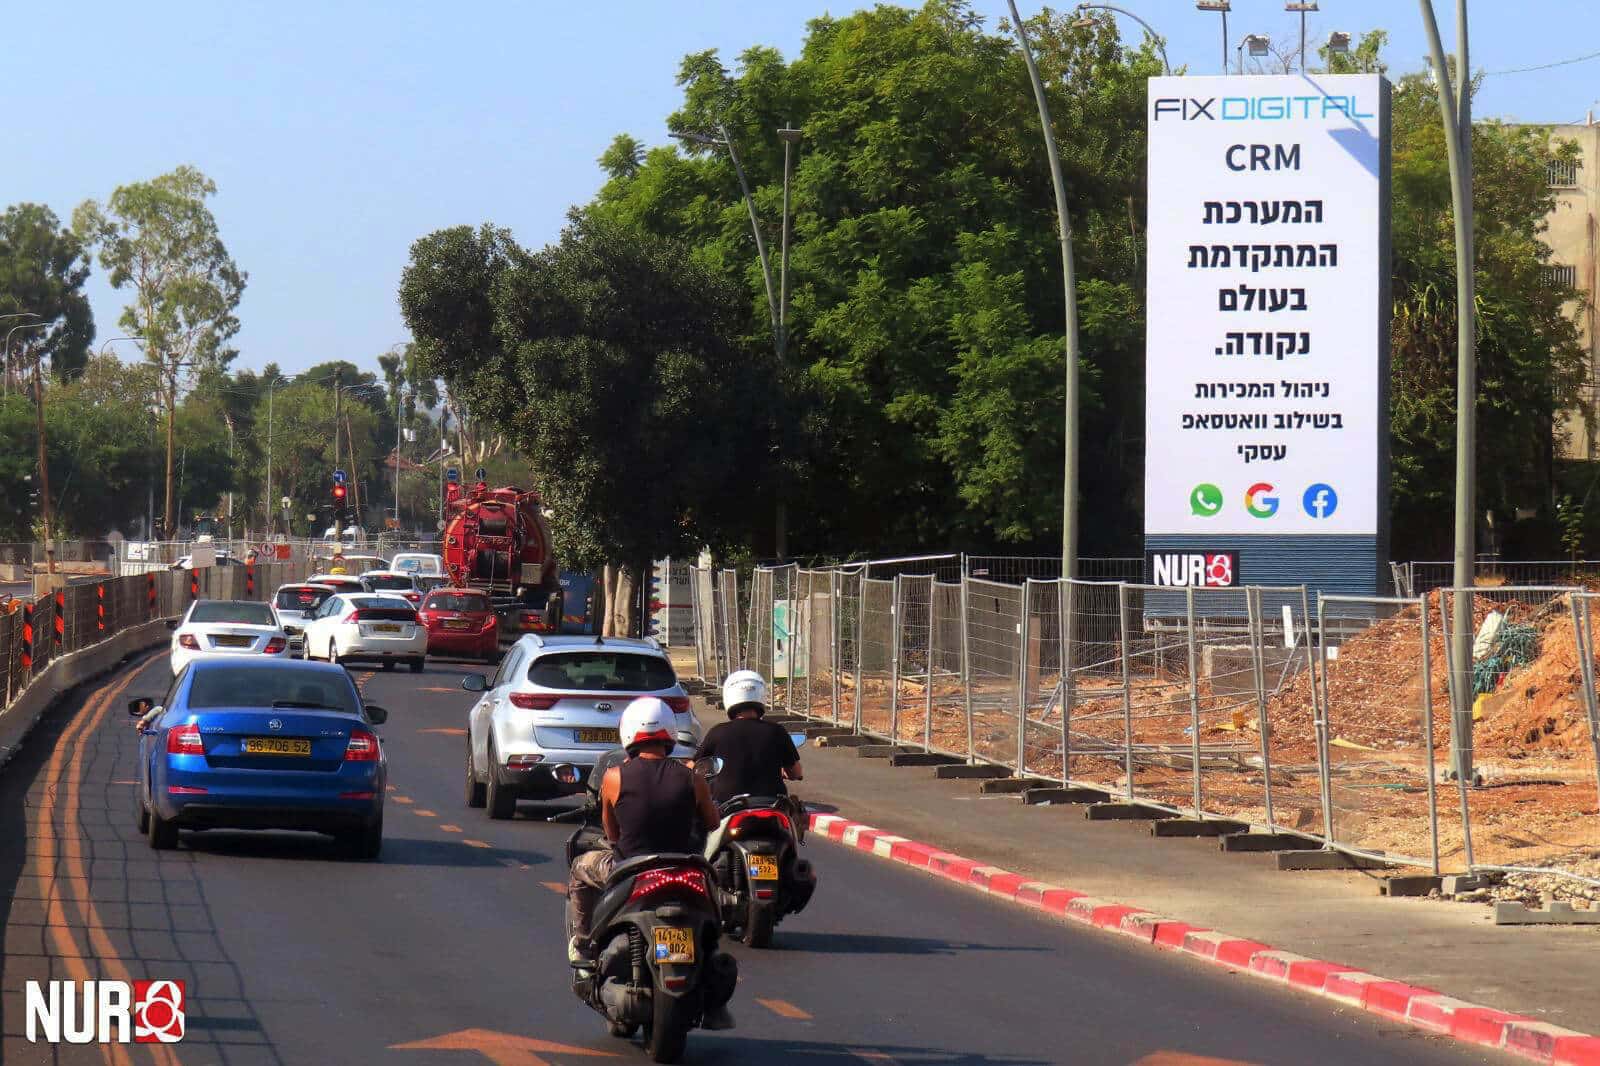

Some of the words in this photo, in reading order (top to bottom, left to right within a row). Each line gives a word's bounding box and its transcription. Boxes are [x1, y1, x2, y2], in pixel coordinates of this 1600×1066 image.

[1154, 97, 1216, 121] FIX
[1222, 95, 1375, 121] DIGITAL
[1225, 143, 1301, 172] CRM
[1202, 199, 1323, 226] המערכת
[1187, 243, 1338, 273] המתקדמת
[1218, 284, 1308, 313] בעולם
[1214, 331, 1311, 361] נקודה.
[1194, 381, 1275, 399] המכירות
[1281, 380, 1330, 399] ניהול
[1182, 412, 1268, 430] וואטסאפ
[1274, 411, 1344, 430] בשילוב
[1236, 443, 1288, 464] עסקי
